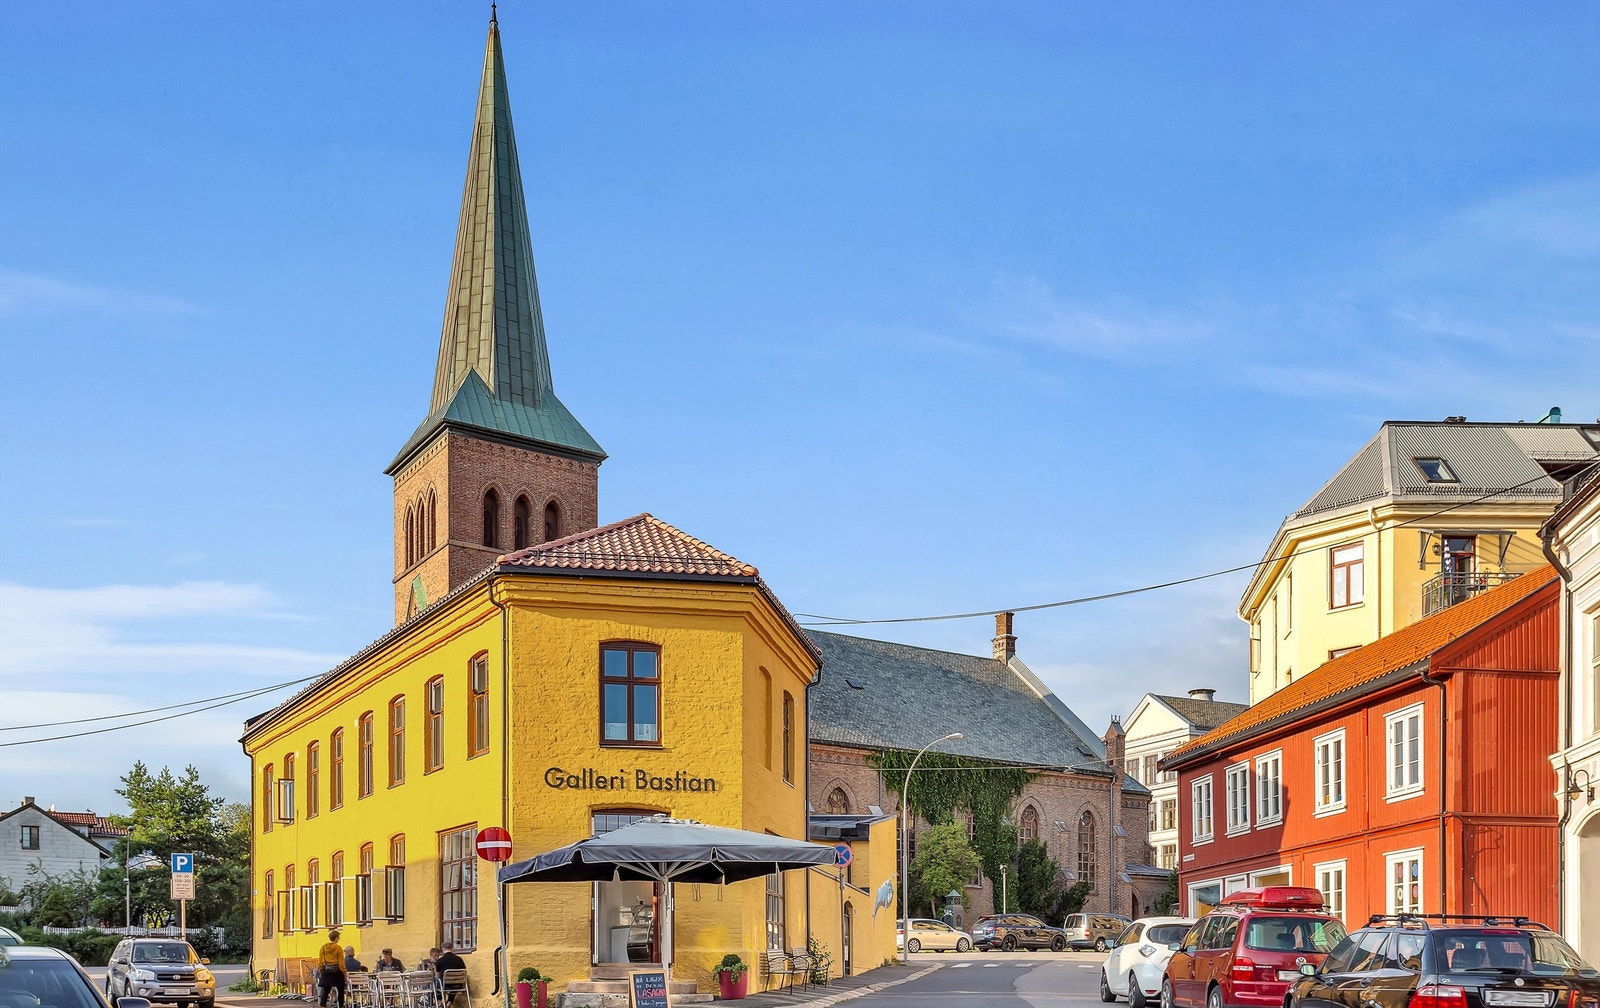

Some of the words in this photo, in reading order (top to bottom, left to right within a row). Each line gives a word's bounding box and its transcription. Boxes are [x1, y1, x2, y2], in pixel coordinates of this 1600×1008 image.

[544, 767, 624, 789] Galleri
[635, 769, 716, 792] Bastian
[176, 856, 188, 871] P
